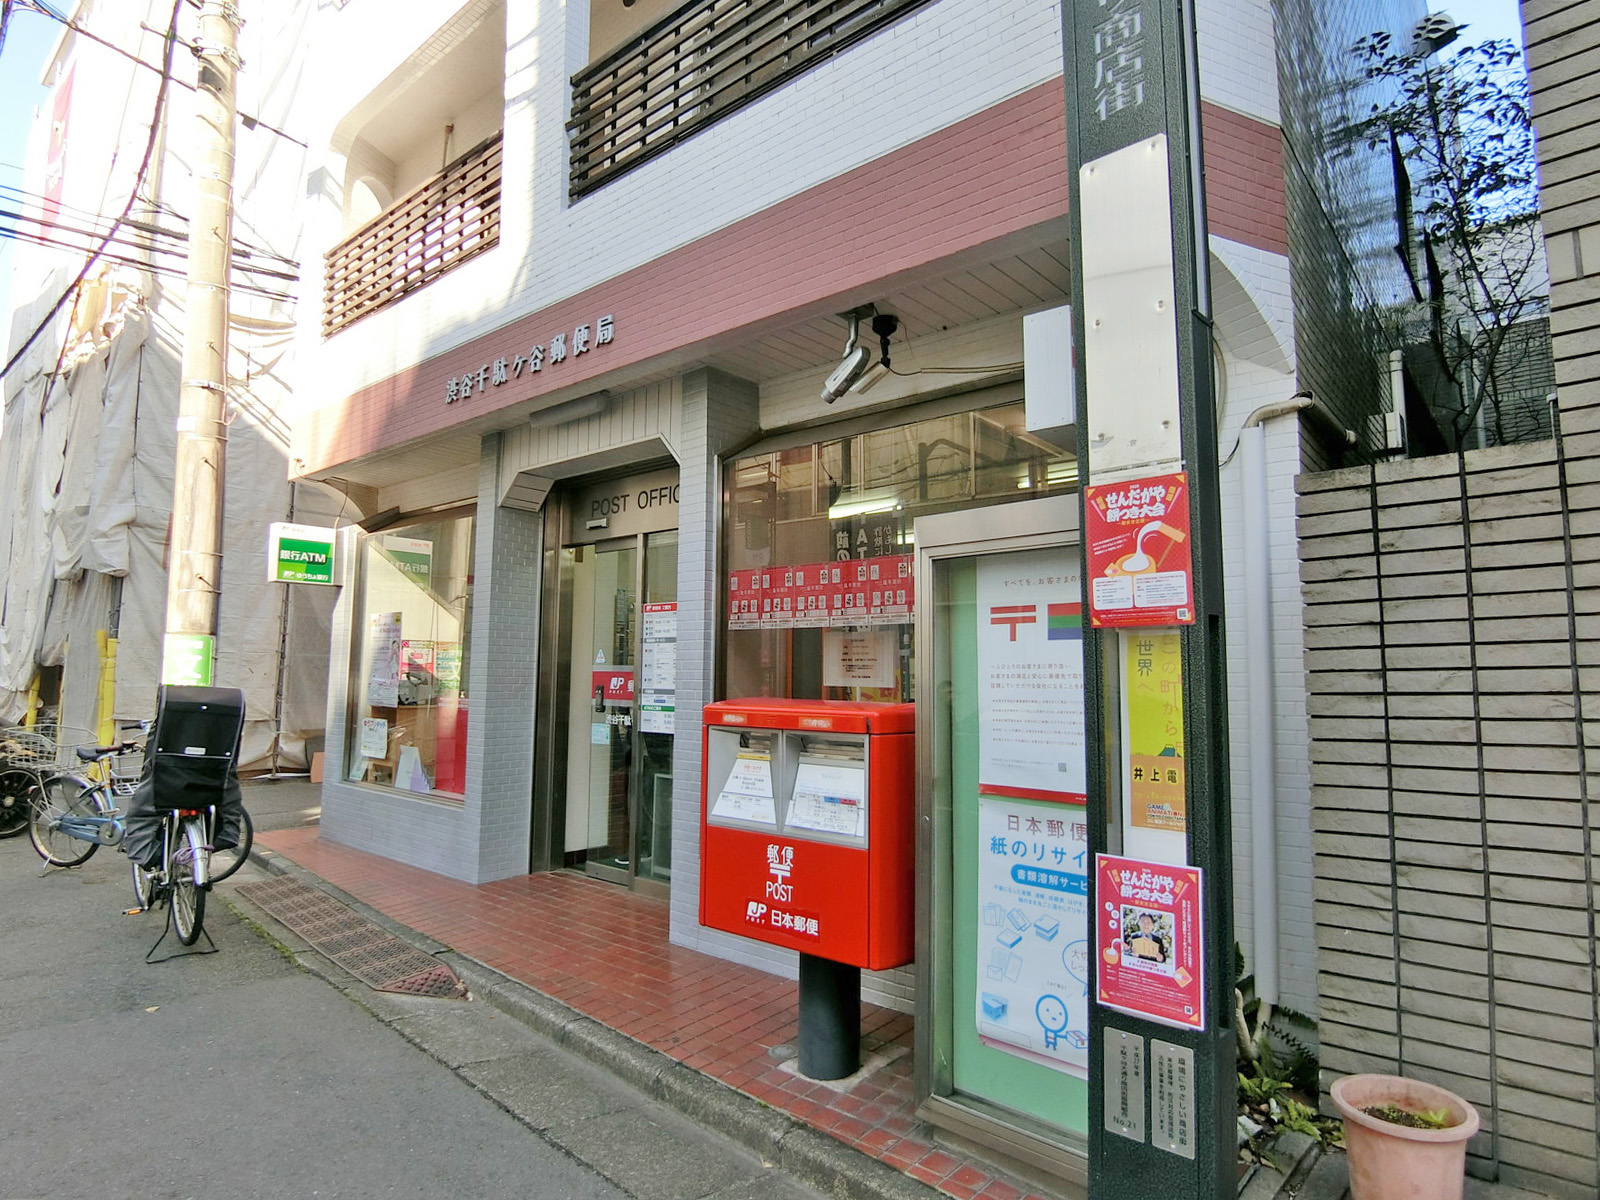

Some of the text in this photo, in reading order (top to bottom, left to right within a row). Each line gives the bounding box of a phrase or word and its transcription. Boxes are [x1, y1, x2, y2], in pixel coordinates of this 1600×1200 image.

[591, 494, 630, 517] POST
[280, 549, 326, 563] 銀行ATM
[1004, 575, 1081, 588] すべてを、お客さまの
[1137, 639, 1154, 692] 世界へ
[766, 843, 794, 867] 郵便
[766, 880, 794, 903] POST
[745, 916, 766, 925] POST
[771, 909, 819, 936] 日本郵便
[1113, 1115, 1137, 1130] No.21
